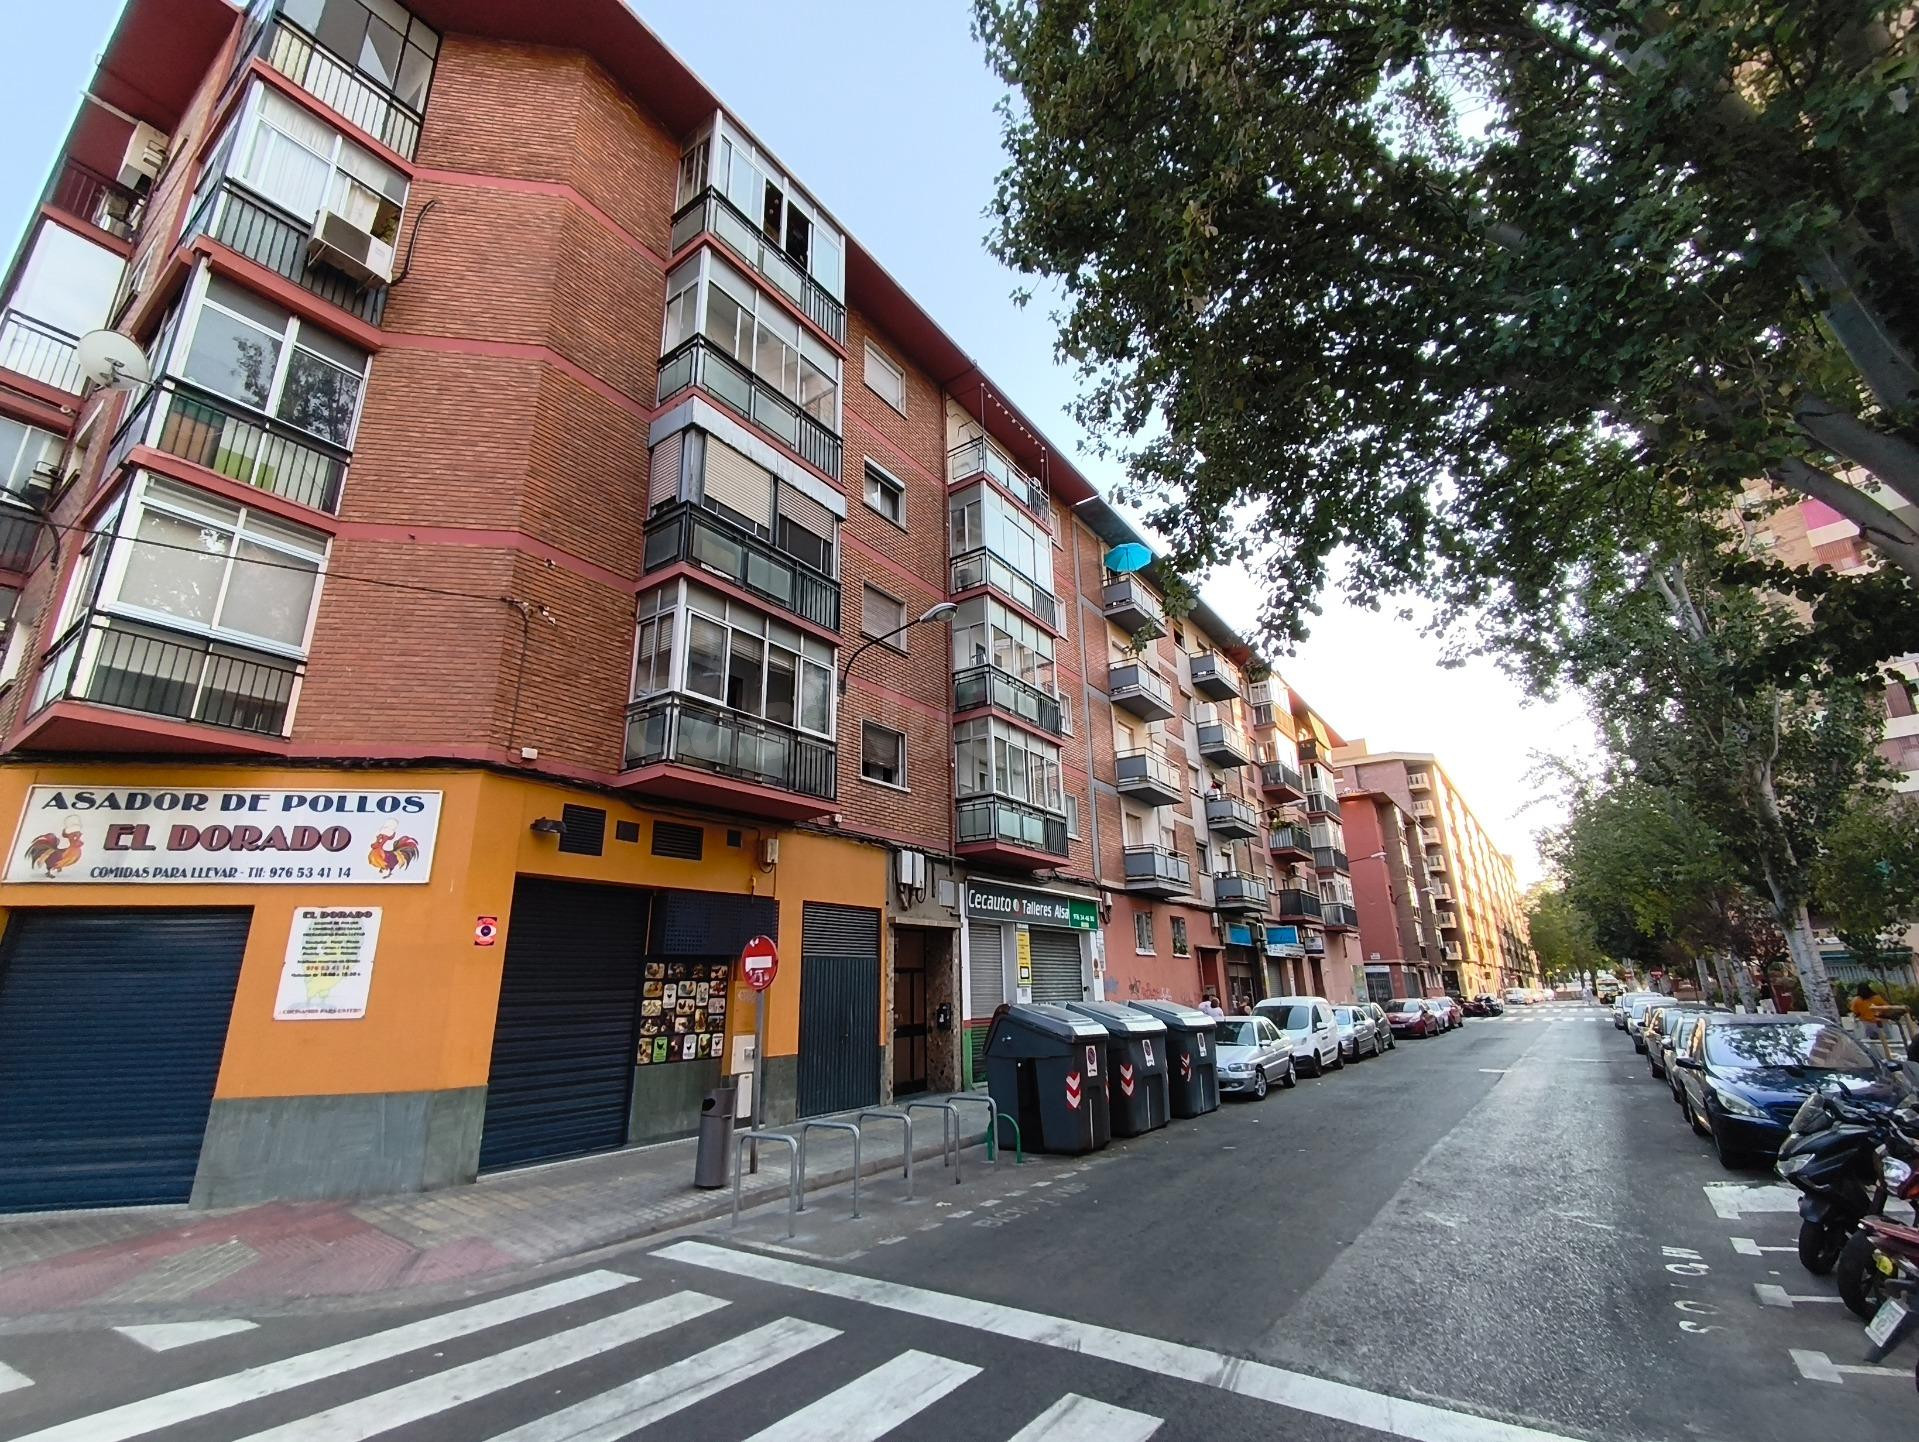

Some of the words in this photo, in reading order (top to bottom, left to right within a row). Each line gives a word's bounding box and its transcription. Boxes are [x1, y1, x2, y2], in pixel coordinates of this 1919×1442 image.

[42, 791, 209, 812] ASADOR
[220, 793, 270, 812] DE
[282, 794, 425, 813] POLLOS
[103, 823, 156, 851] EL
[166, 824, 352, 852] DORADO
[90, 866, 150, 879] COMIDAS
[152, 867, 187, 879] PARA
[190, 867, 238, 879] LLEVAR
[269, 867, 293, 878] 976
[296, 867, 313, 878] 53
[317, 867, 331, 878] 41
[338, 867, 351, 878] 14
[968, 890, 1012, 912] Cecauto
[1022, 899, 1052, 917] Talleres
